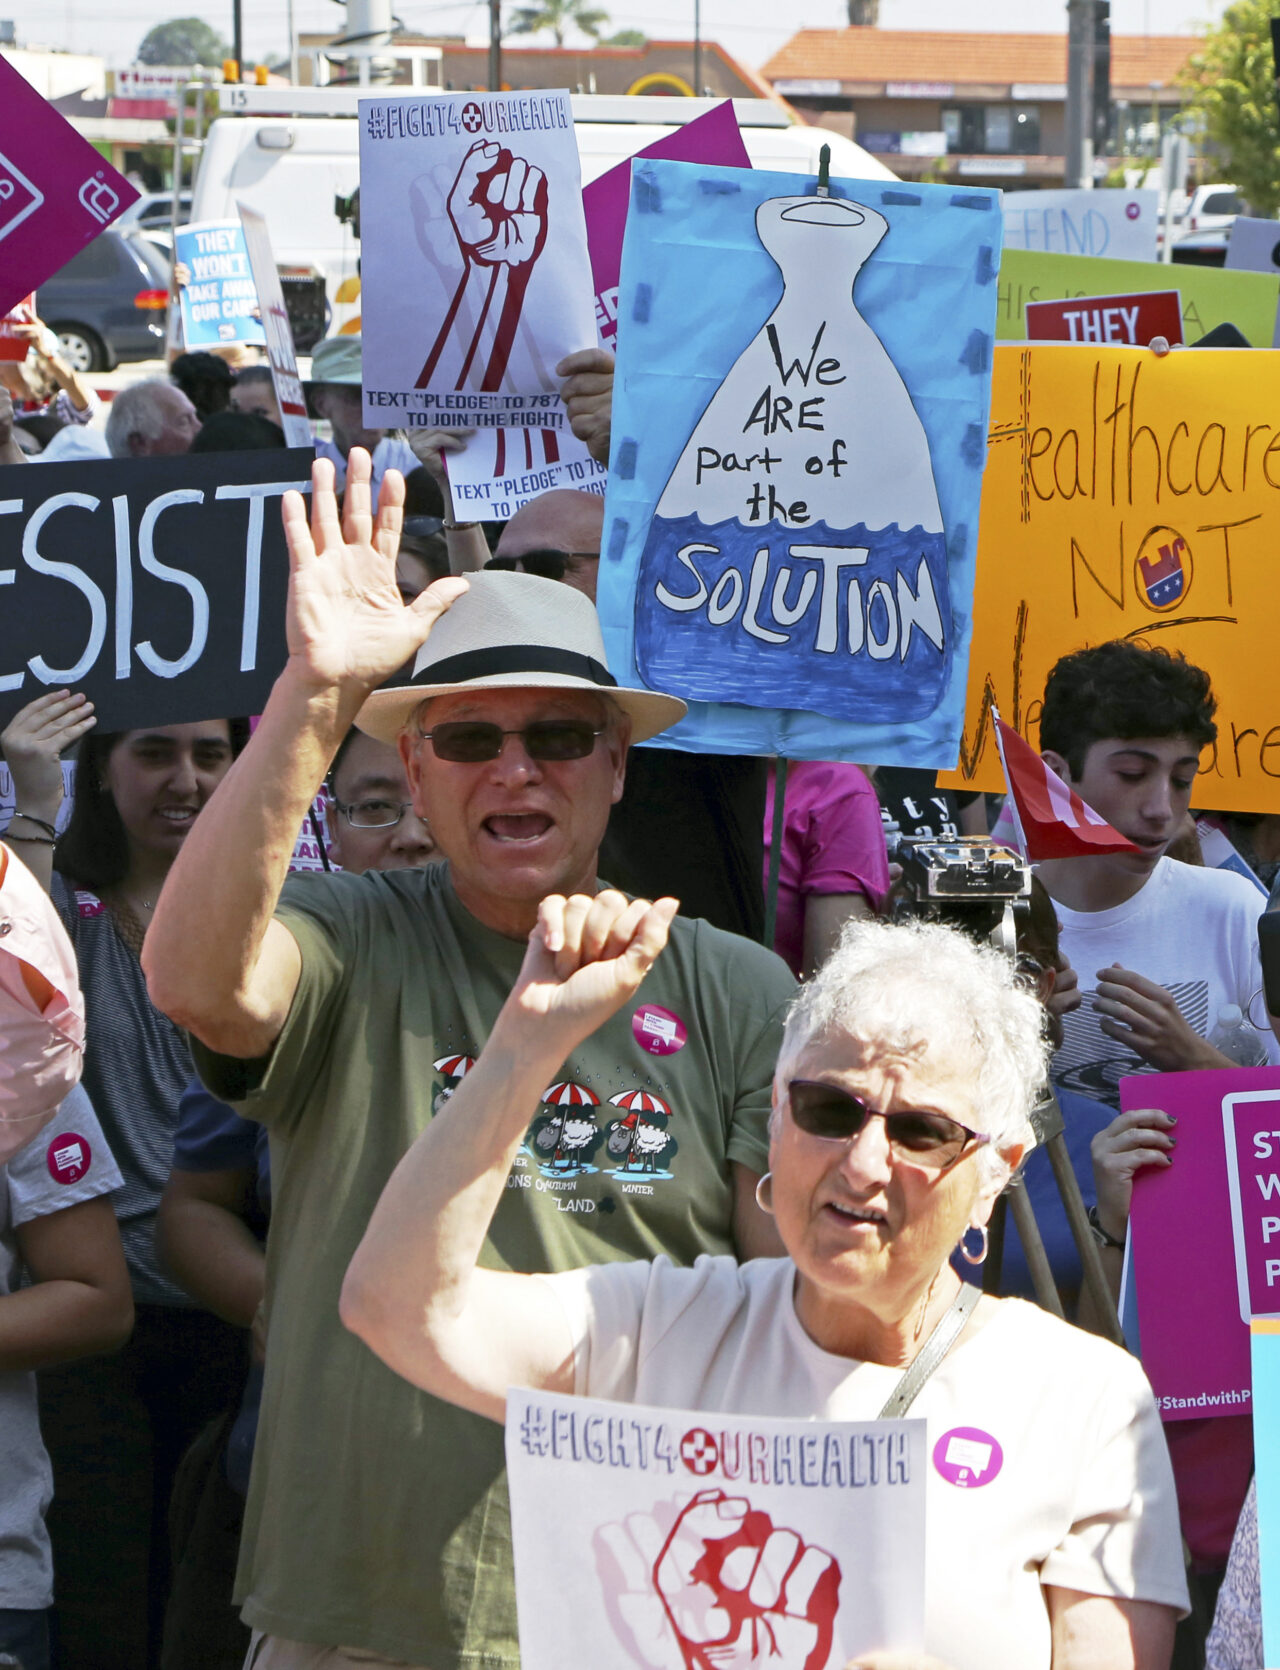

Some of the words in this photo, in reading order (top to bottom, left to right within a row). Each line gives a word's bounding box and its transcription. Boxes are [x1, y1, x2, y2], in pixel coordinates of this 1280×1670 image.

[231, 90, 247, 106] 15
[195, 230, 239, 254] THEY
[1003, 208, 1111, 257] EFEND
[192, 254, 247, 277] WON'T
[187, 283, 220, 303] TAKE
[192, 304, 220, 323] OUR
[1062, 305, 1140, 344] THEY
[766, 321, 847, 387] We
[366, 391, 410, 407] TEXT
[505, 396, 524, 408] TO
[529, 394, 562, 408] 787
[743, 385, 826, 436] ARE
[406, 412, 428, 426] TO
[432, 412, 468, 426] JOIN
[474, 412, 508, 426] THE
[511, 412, 564, 429] FIGHT!
[697, 447, 783, 485] part
[805, 439, 849, 477] of
[454, 483, 491, 500] TEXT
[565, 463, 586, 481] TO
[491, 502, 511, 517] TO
[746, 483, 811, 523] the
[655, 543, 945, 664] SOLUTION
[621, 1184, 654, 1196] WINTER
[1155, 1389, 1251, 1411] #StandwithP
